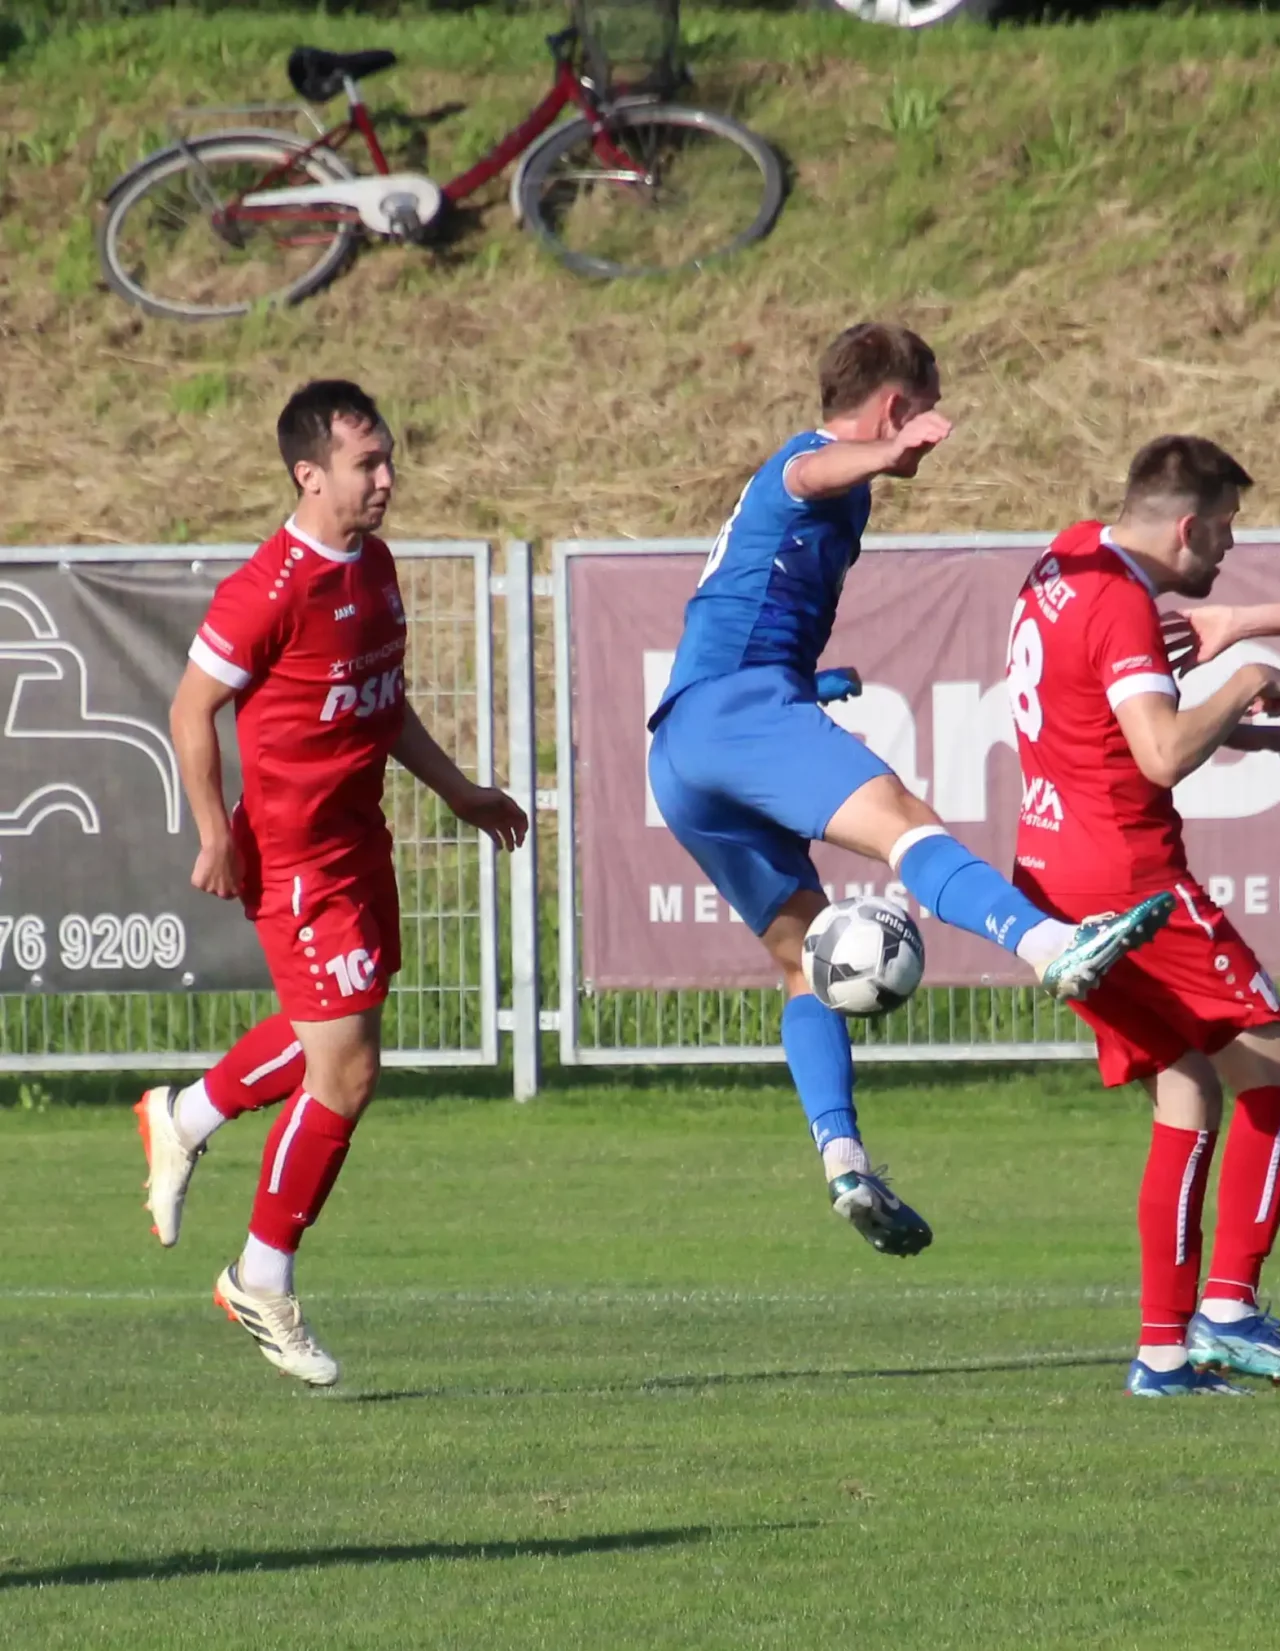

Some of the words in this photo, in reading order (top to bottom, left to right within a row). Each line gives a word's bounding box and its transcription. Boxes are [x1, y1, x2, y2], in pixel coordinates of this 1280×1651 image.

[1004, 598, 1045, 743] 18
[58, 912, 187, 971] 9209
[325, 949, 375, 998] 10
